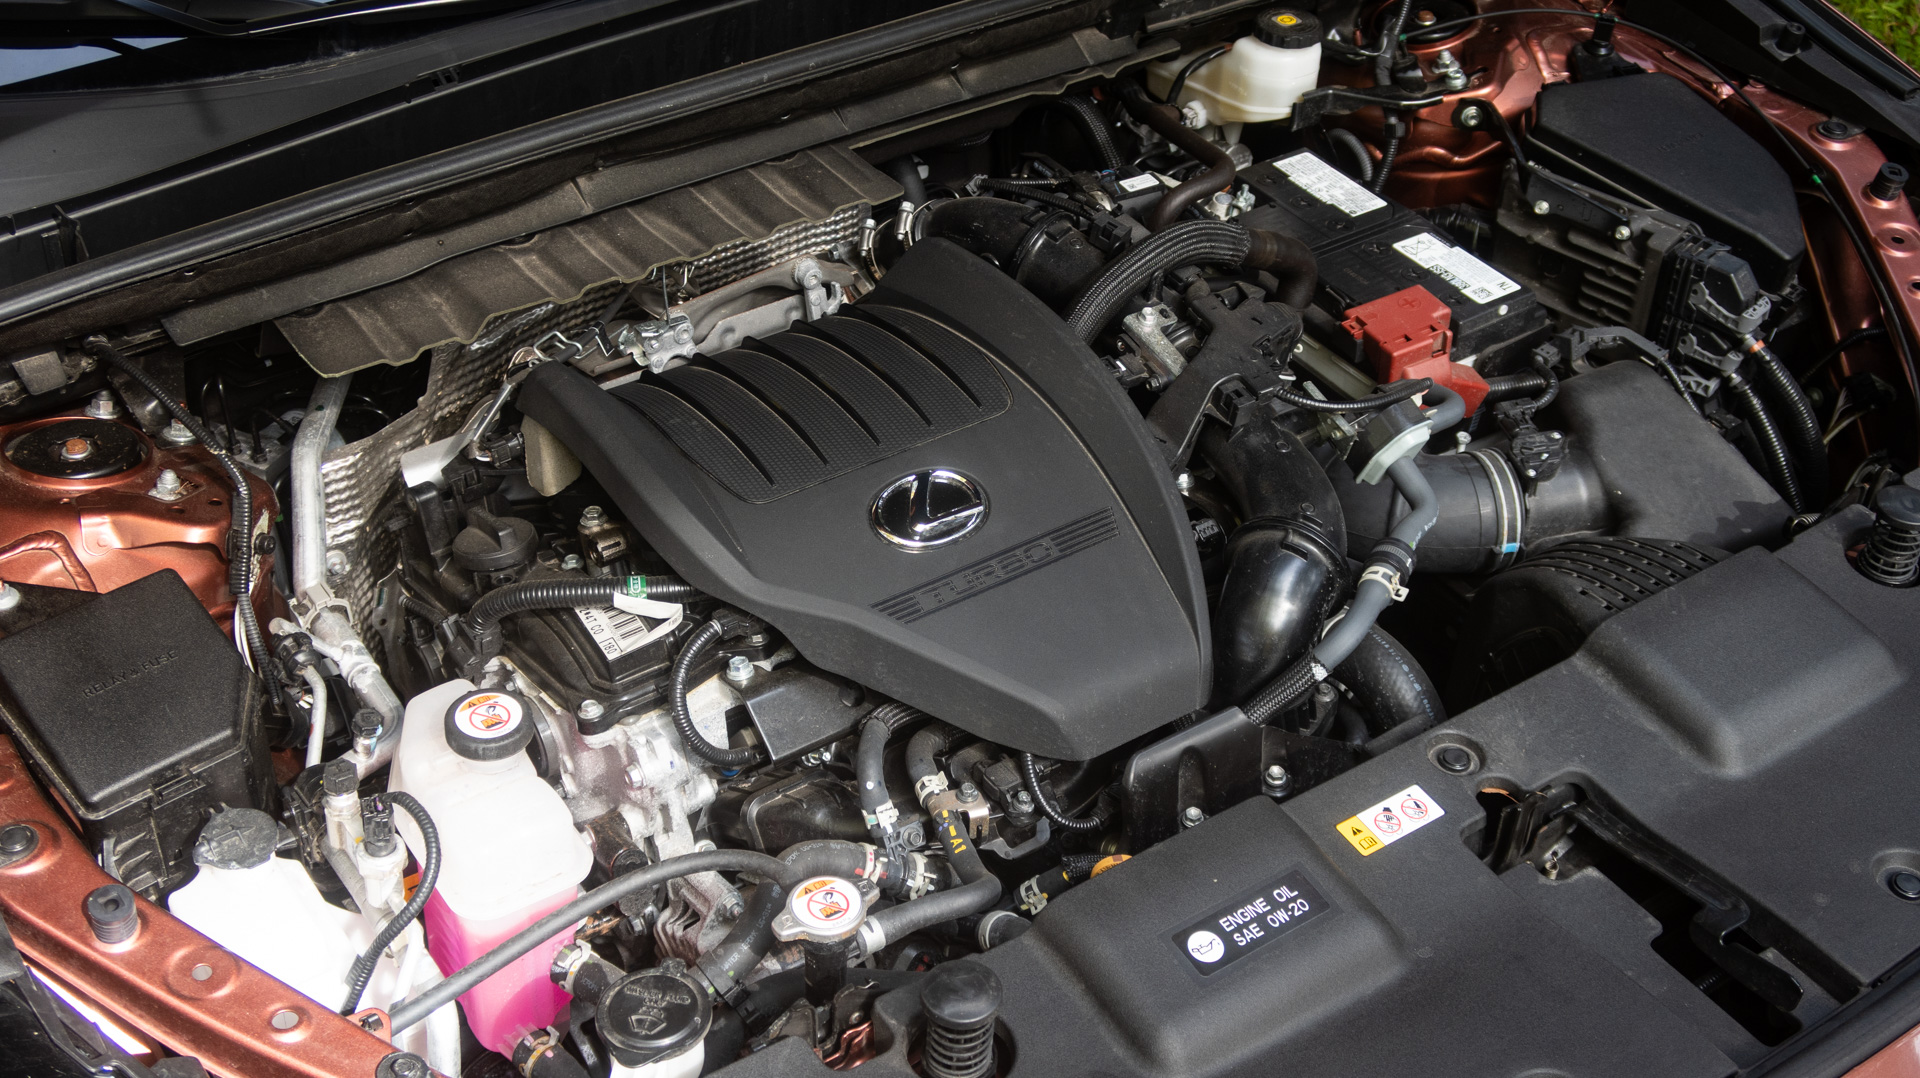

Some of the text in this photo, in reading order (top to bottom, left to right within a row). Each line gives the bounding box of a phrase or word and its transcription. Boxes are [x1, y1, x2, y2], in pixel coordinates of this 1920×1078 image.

[915, 542, 1053, 603] TURBO
[82, 650, 179, 699] RELAY & FUSE
[1218, 885, 1299, 932] ENGINE OIL
[1232, 898, 1310, 946] SAE 0W-20
